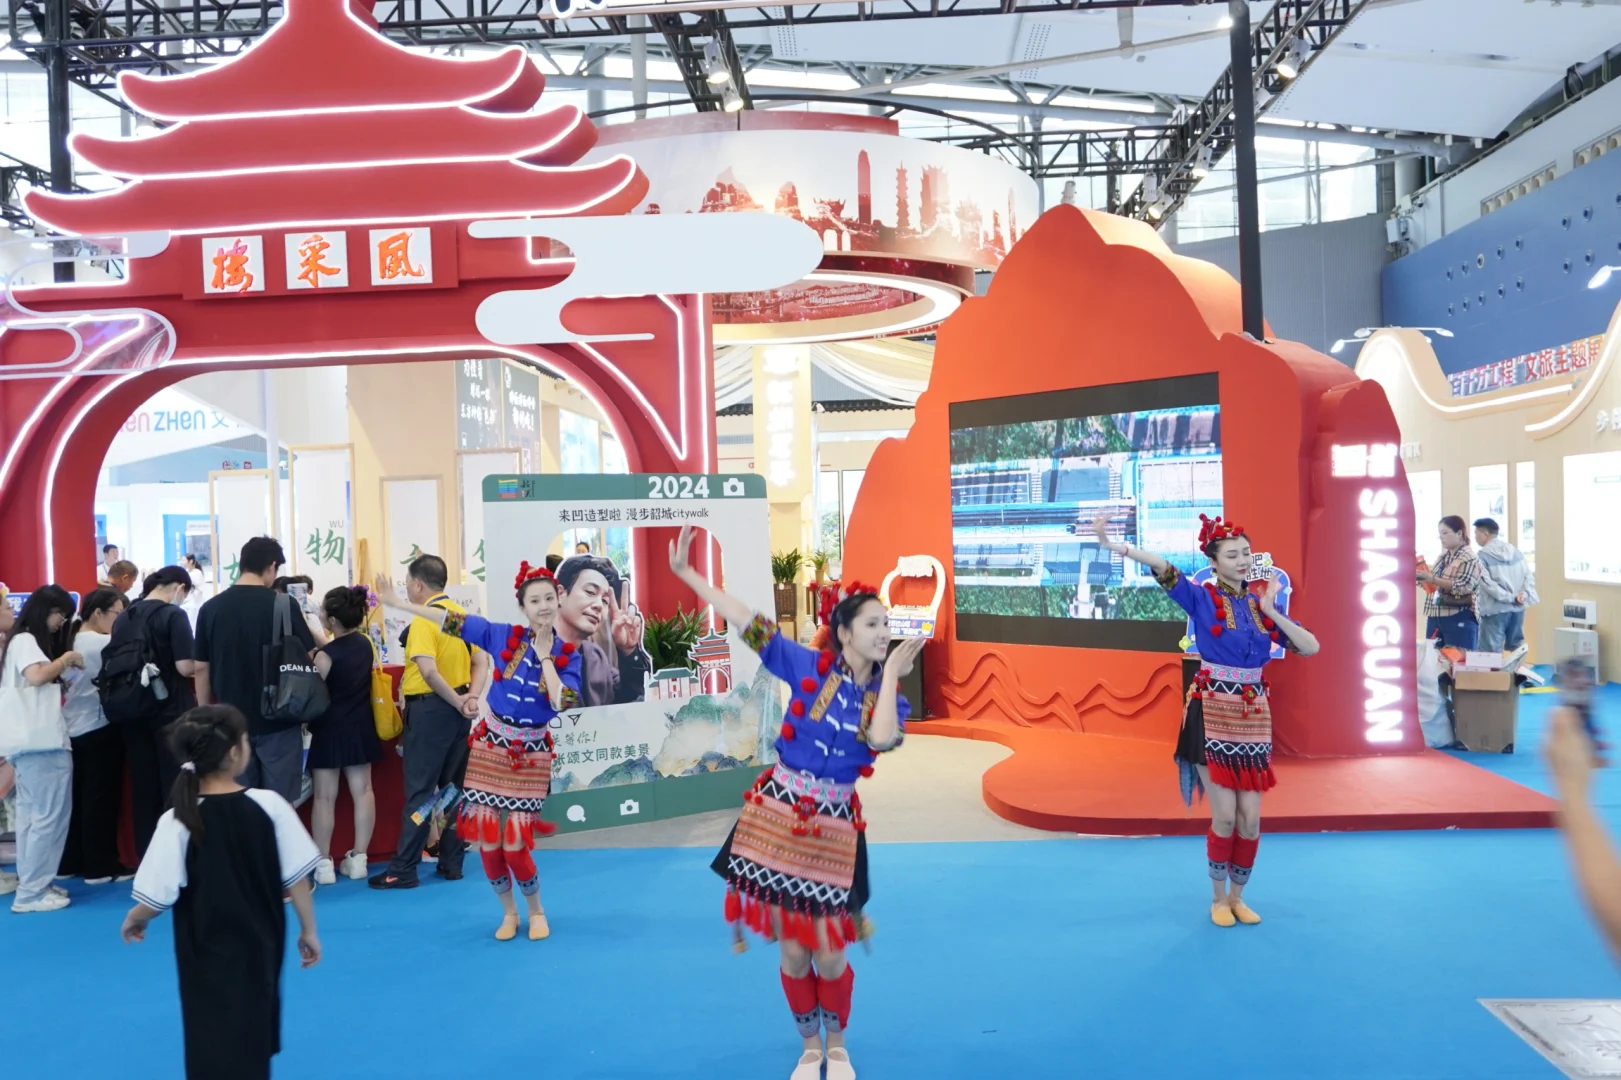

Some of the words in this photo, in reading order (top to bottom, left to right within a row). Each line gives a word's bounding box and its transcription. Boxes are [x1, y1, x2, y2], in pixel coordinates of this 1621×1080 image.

[648, 475, 710, 499] 2024
[329, 520, 344, 528] WU
[558, 509, 622, 522] 来凹造型啦
[304, 528, 345, 565] 物
[1358, 488, 1404, 743] SHAOGUAN
[280, 663, 304, 673] DEAN
[305, 665, 312, 673] &
